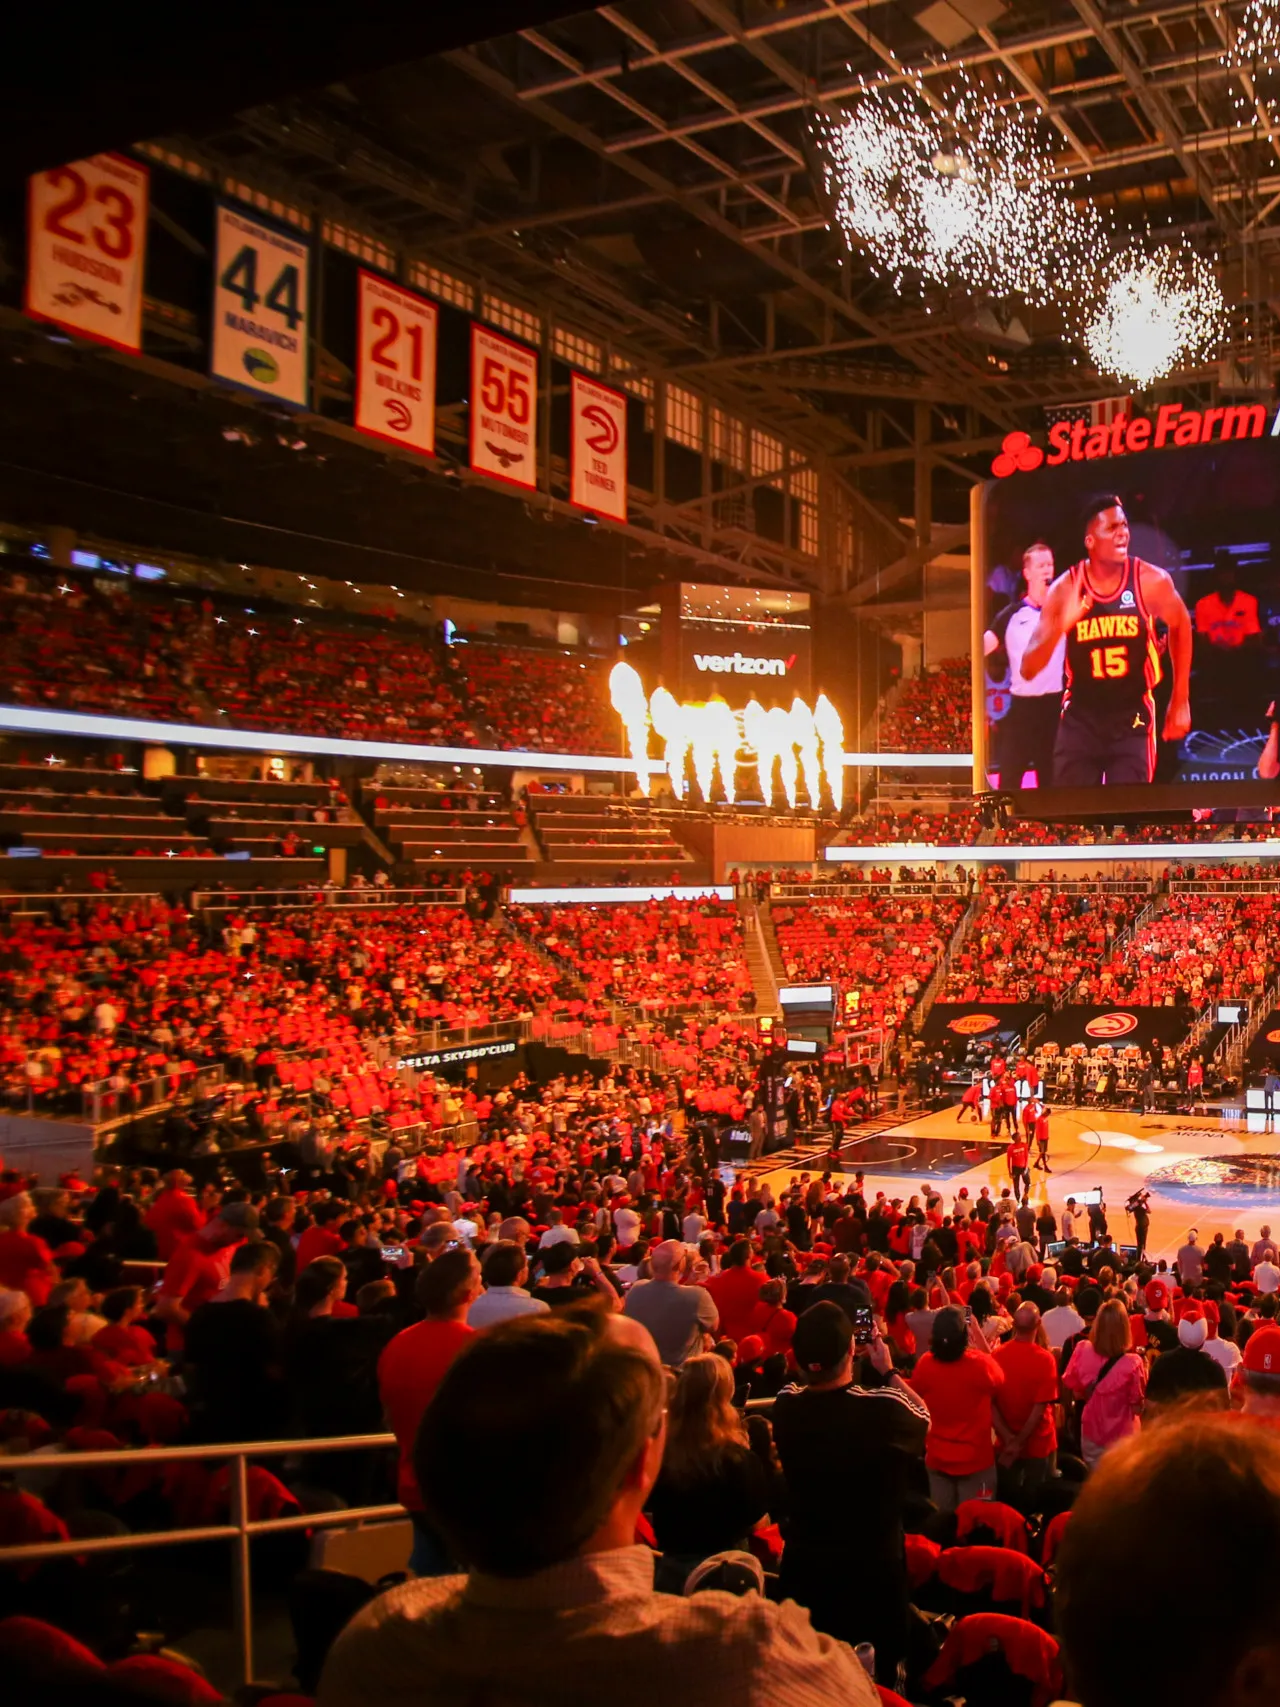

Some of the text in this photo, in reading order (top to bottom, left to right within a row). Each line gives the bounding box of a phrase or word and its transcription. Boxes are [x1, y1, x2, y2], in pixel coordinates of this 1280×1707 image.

[44, 165, 136, 261] 23
[51, 243, 124, 288] HUDSON
[219, 245, 304, 332] 44
[225, 310, 299, 355] MARAVICH
[370, 306, 423, 382] 21
[374, 370, 422, 402] WILKINS
[481, 356, 530, 425] 55
[480, 414, 529, 446] MUTOMBO
[584, 469, 616, 493] TURNER
[592, 457, 608, 474] TED
[1076, 614, 1140, 642] HAWKS
[693, 652, 787, 676] verizon
[1090, 645, 1128, 679] 15
[396, 1054, 442, 1071] DELTA
[1171, 1131, 1225, 1139] ARENA
